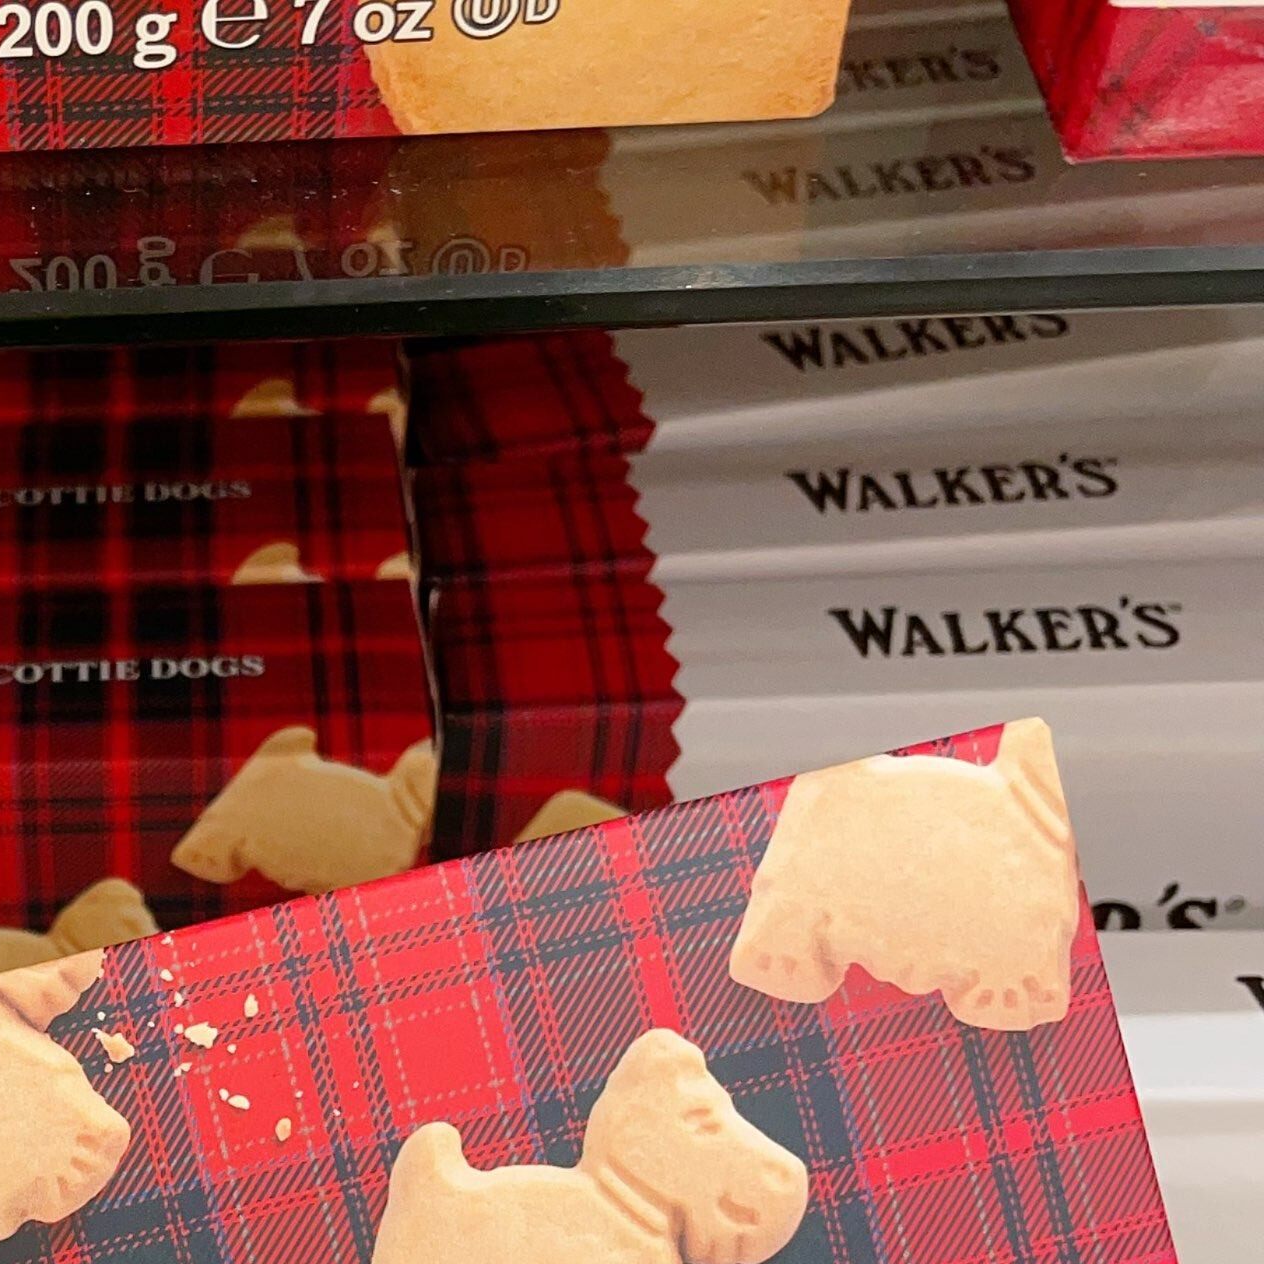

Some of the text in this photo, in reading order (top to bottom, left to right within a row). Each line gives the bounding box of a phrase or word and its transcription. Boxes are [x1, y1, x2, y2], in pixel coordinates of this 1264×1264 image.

[132, 10, 178, 70] g
[352, 0, 435, 43] oz
[836, 45, 1004, 95] KER'S
[741, 144, 1036, 204] WALKER'S
[758, 313, 1070, 372] WALKERS
[144, 479, 252, 502] DOGS
[783, 451, 1120, 515] WALKER'S
[829, 595, 1182, 660] WALKER'S
[150, 654, 266, 680] DOGS
